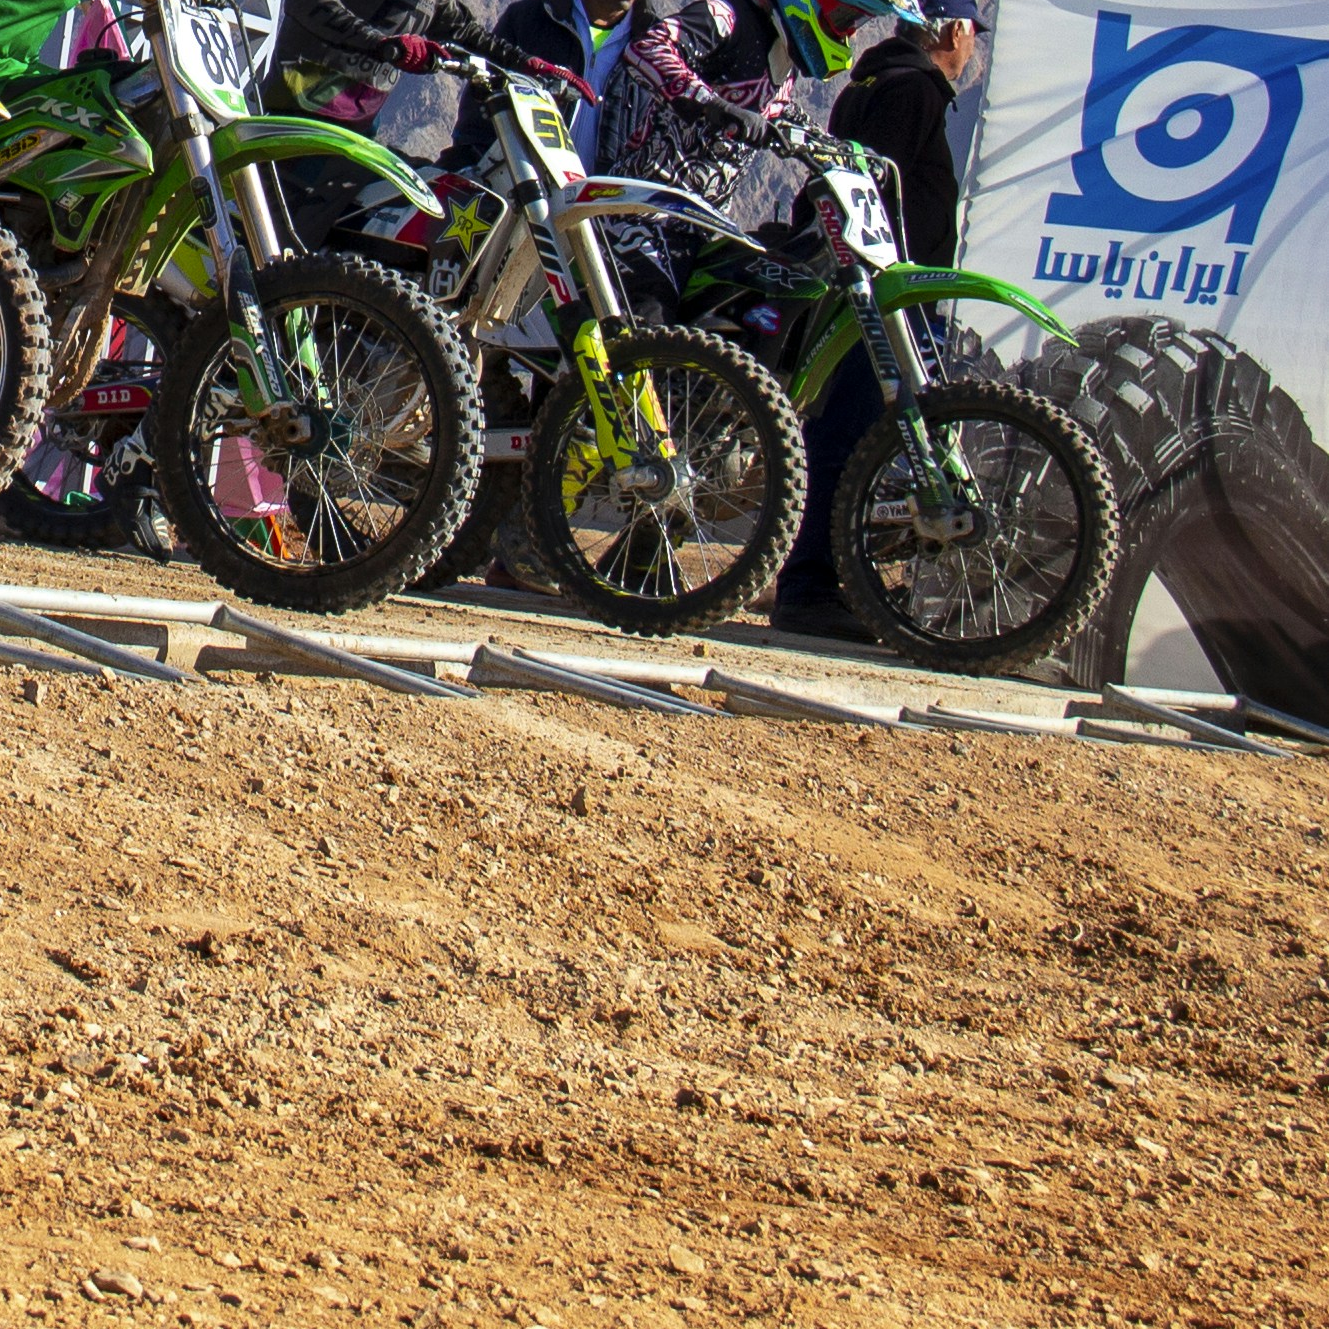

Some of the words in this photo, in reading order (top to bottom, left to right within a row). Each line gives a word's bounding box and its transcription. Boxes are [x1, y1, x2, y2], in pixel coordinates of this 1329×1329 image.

[190, 19, 241, 90] 88
[37, 98, 102, 128] KX
[816, 199, 857, 267] SHOWA
[1134, 250, 1249, 305] ایران
[98, 389, 131, 405] D.I.D
[585, 356, 631, 446] FOX
[897, 418, 928, 488] DUNLOP
